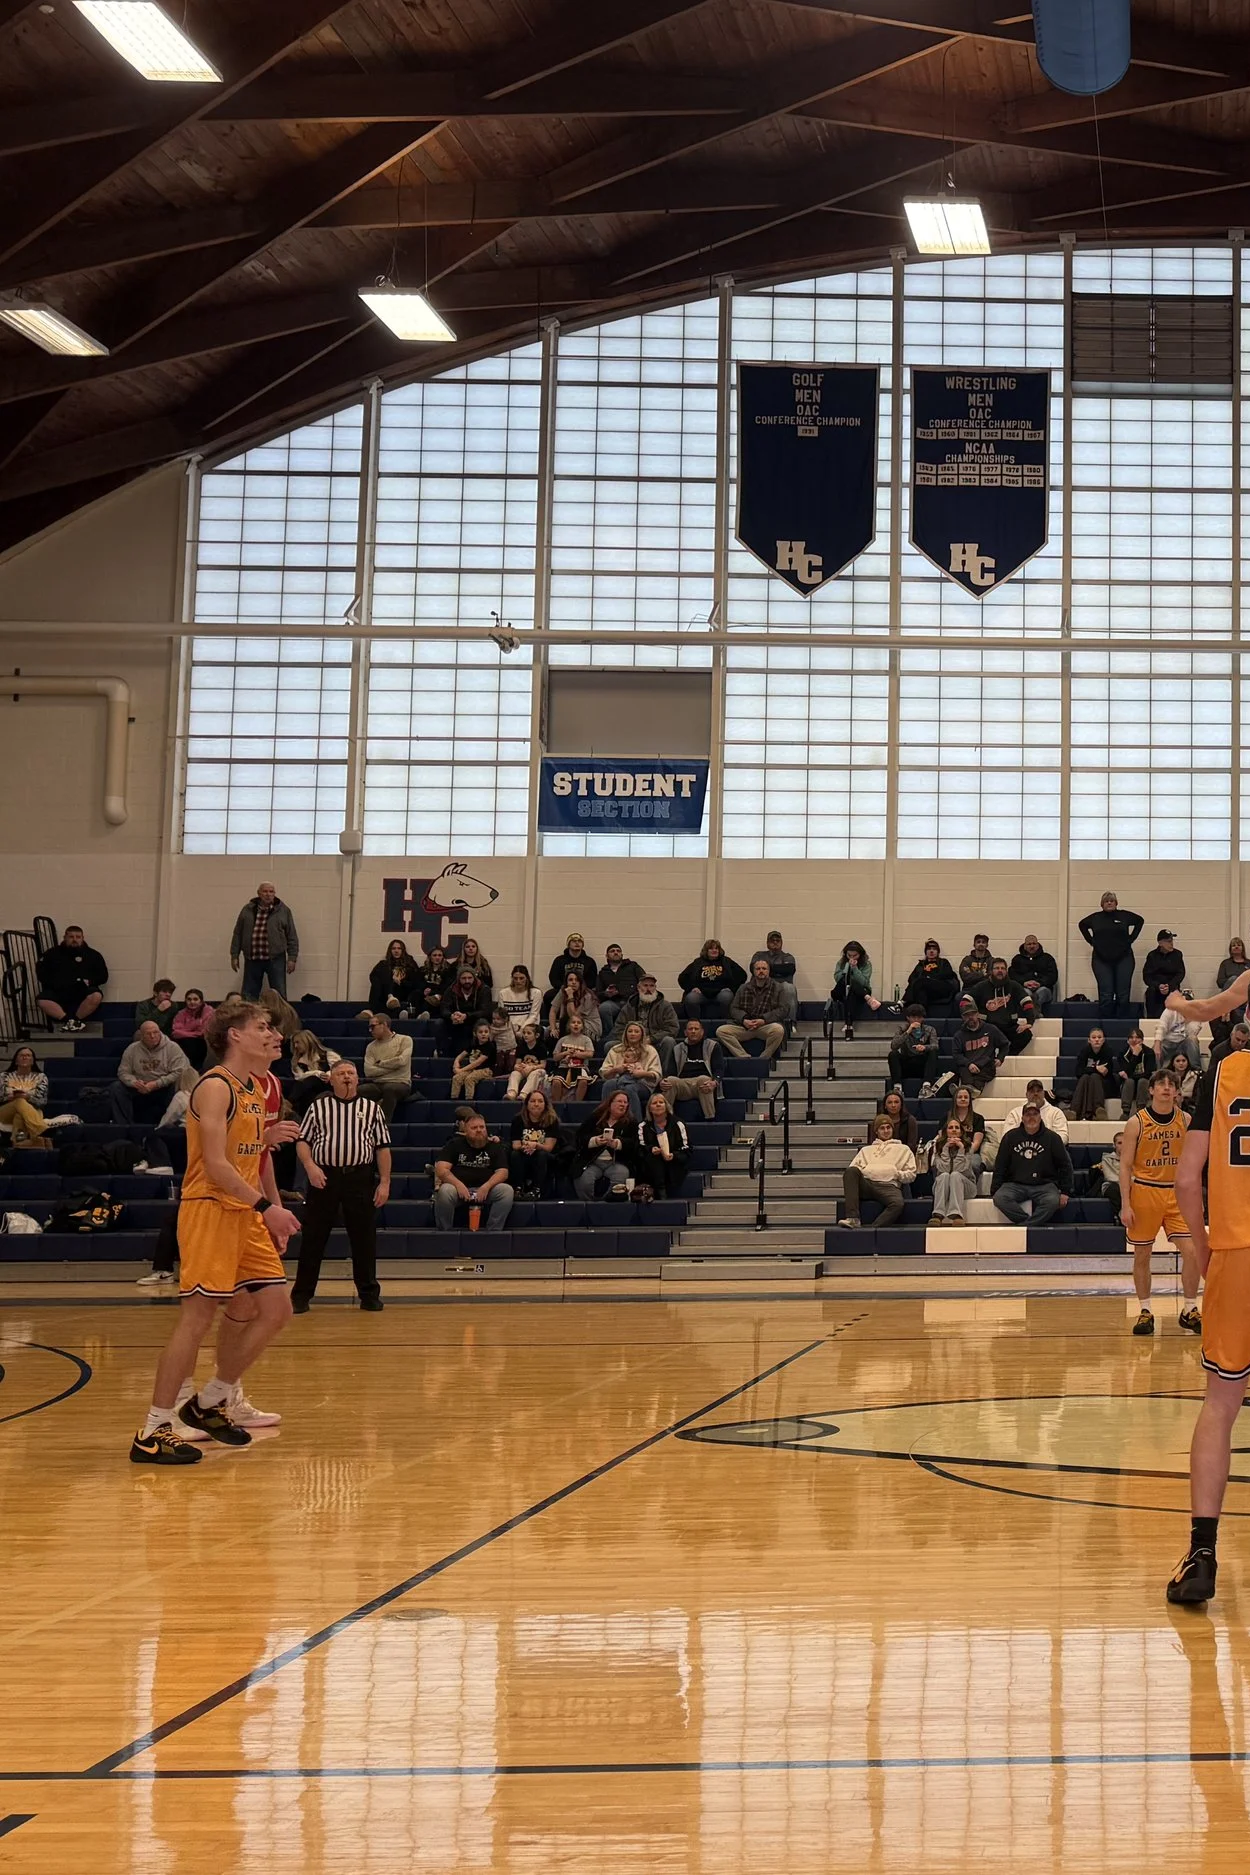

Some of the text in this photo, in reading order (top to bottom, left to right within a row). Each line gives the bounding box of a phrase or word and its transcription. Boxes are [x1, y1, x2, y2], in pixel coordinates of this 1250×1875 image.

[792, 373, 825, 387] GOLF
[945, 376, 1017, 390] WRESTLING
[795, 389, 821, 403] MEN
[968, 393, 993, 406] MEN
[796, 404, 820, 416] OAC
[969, 408, 992, 419] OAC
[755, 416, 861, 426] CONFERENCE CHAMPION
[929, 419, 1032, 429] CONFERENCE CHAMPION
[965, 442, 995, 454] NCAA
[945, 454, 1016, 464] CHAMPIONSHIPS
[776, 540, 823, 585] HC
[949, 543, 996, 586] HC
[552, 772, 697, 798] STUDENT
[577, 800, 671, 818] SECTION
[381, 878, 469, 959] HC
[1148, 1130, 1174, 1141] JAMES
[1162, 1140, 1170, 1156] 2
[1145, 1157, 1178, 1167] GARFIE
